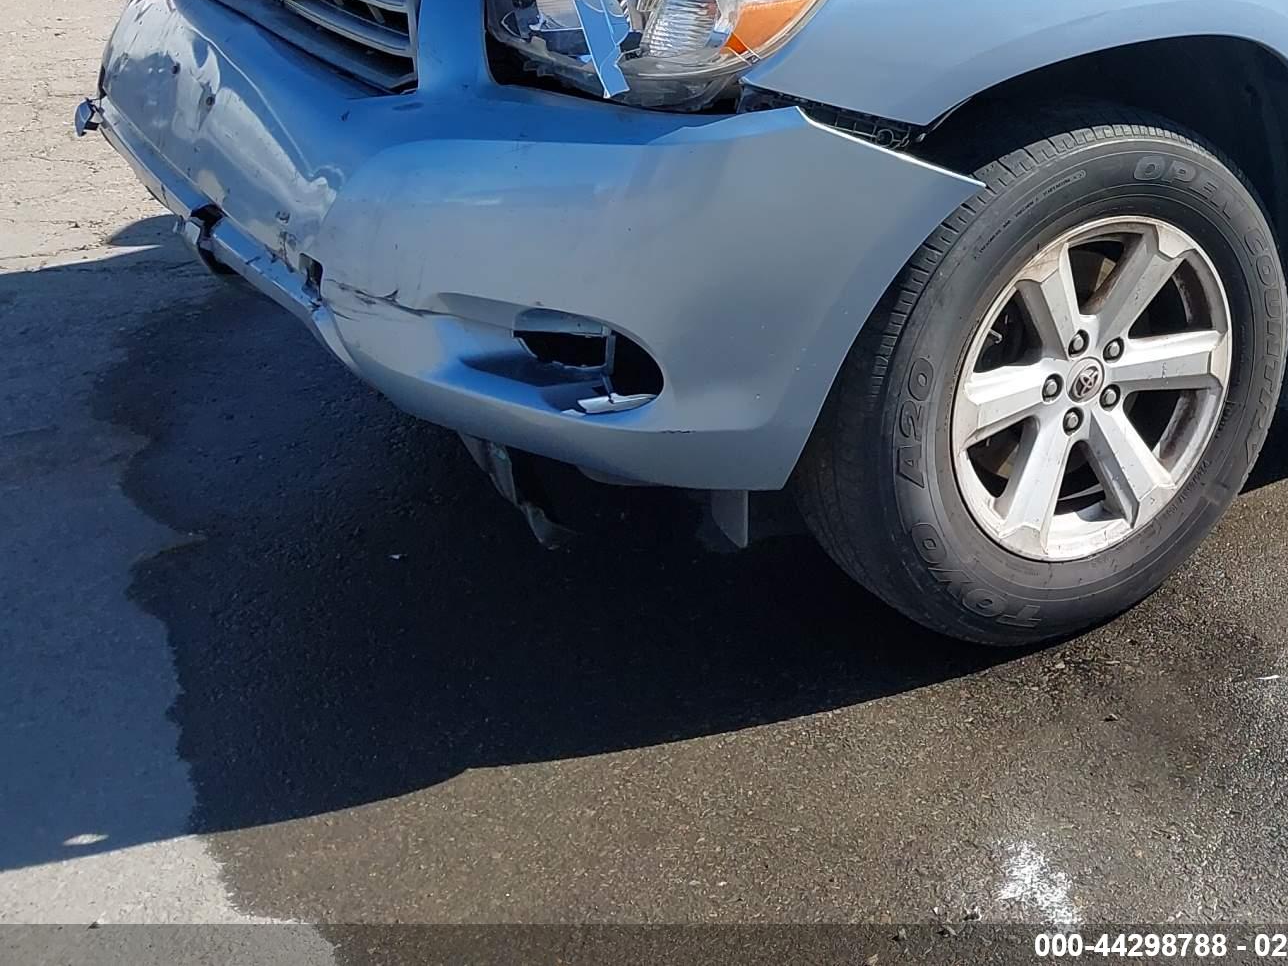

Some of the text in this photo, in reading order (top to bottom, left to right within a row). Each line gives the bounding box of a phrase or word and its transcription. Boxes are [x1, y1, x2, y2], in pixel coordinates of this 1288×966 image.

[1133, 155, 1284, 465] OPEN COUNTRY
[896, 357, 1043, 628] TOYO A20
